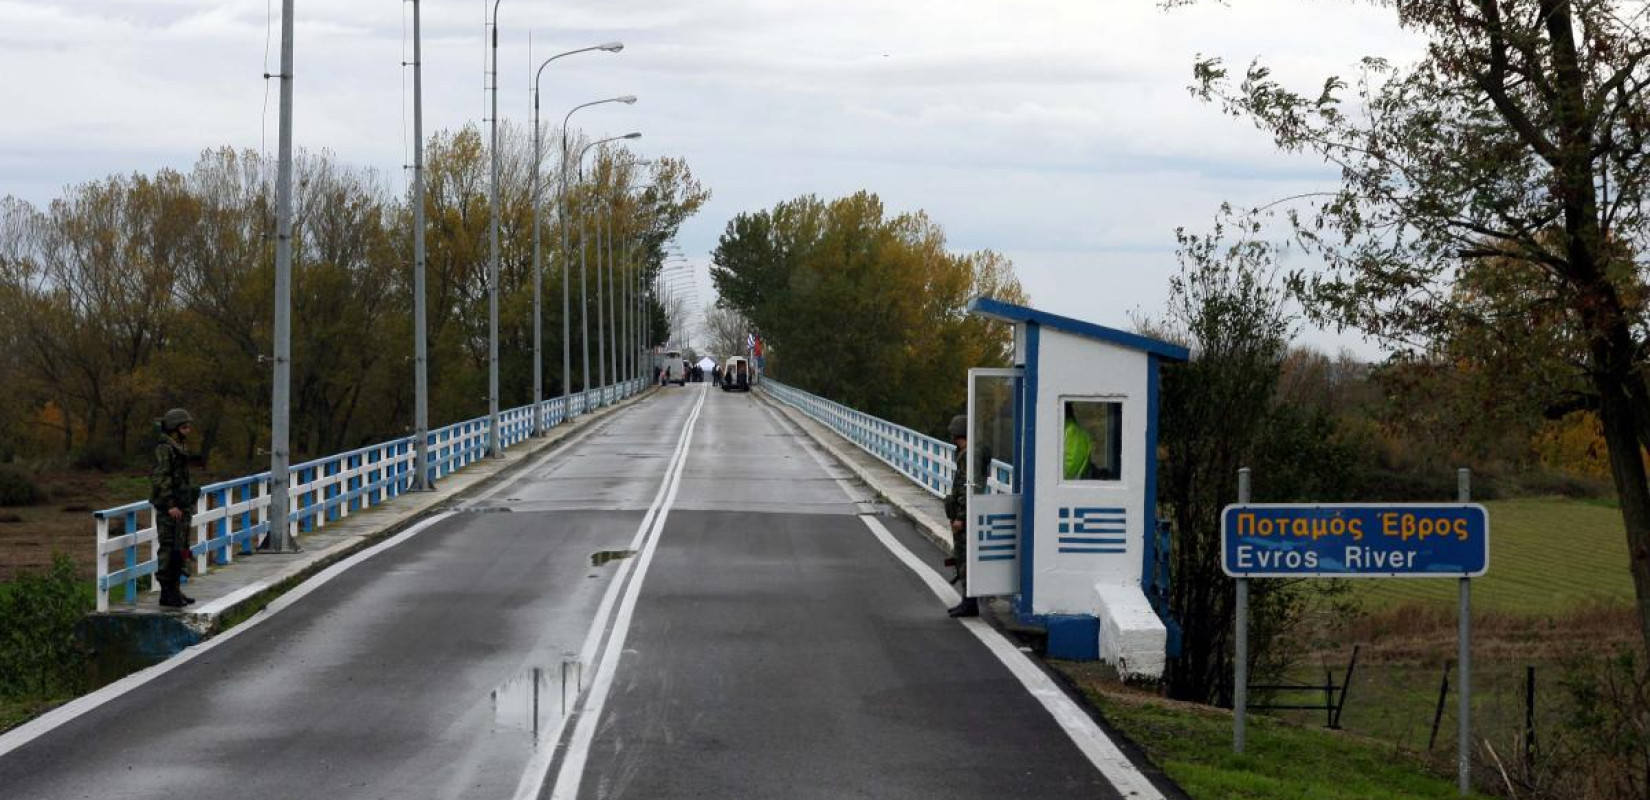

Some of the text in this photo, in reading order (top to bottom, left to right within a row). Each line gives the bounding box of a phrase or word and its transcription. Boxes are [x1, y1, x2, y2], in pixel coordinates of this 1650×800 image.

[1236, 511, 1469, 540] Ποταμός Έβρος
[1236, 545, 1417, 569] Evros River
